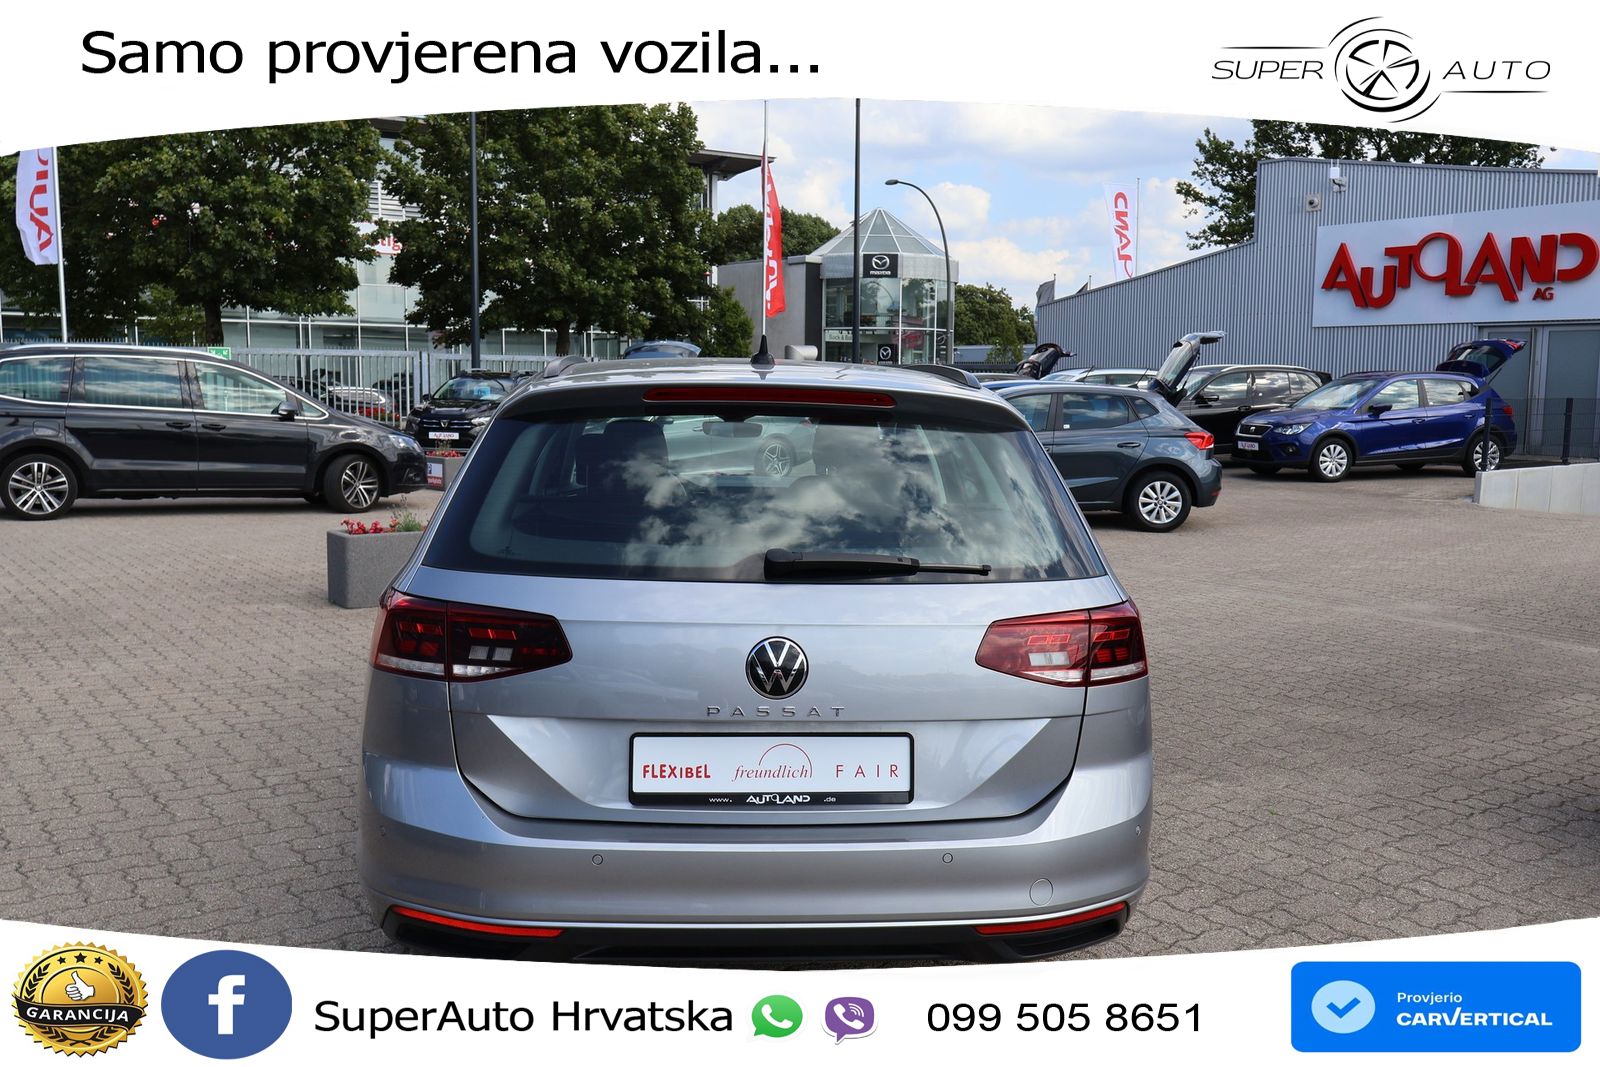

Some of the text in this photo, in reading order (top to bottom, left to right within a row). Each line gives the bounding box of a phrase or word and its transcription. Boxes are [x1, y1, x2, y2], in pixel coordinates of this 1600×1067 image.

[1321, 232, 1600, 308] AUTOLAND
[1532, 287, 1554, 301] AG
[706, 705, 845, 718] PASSAT
[642, 763, 899, 782] FLEXIBEL freundlich FAIR
[746, 793, 811, 805] AUTOLAND
